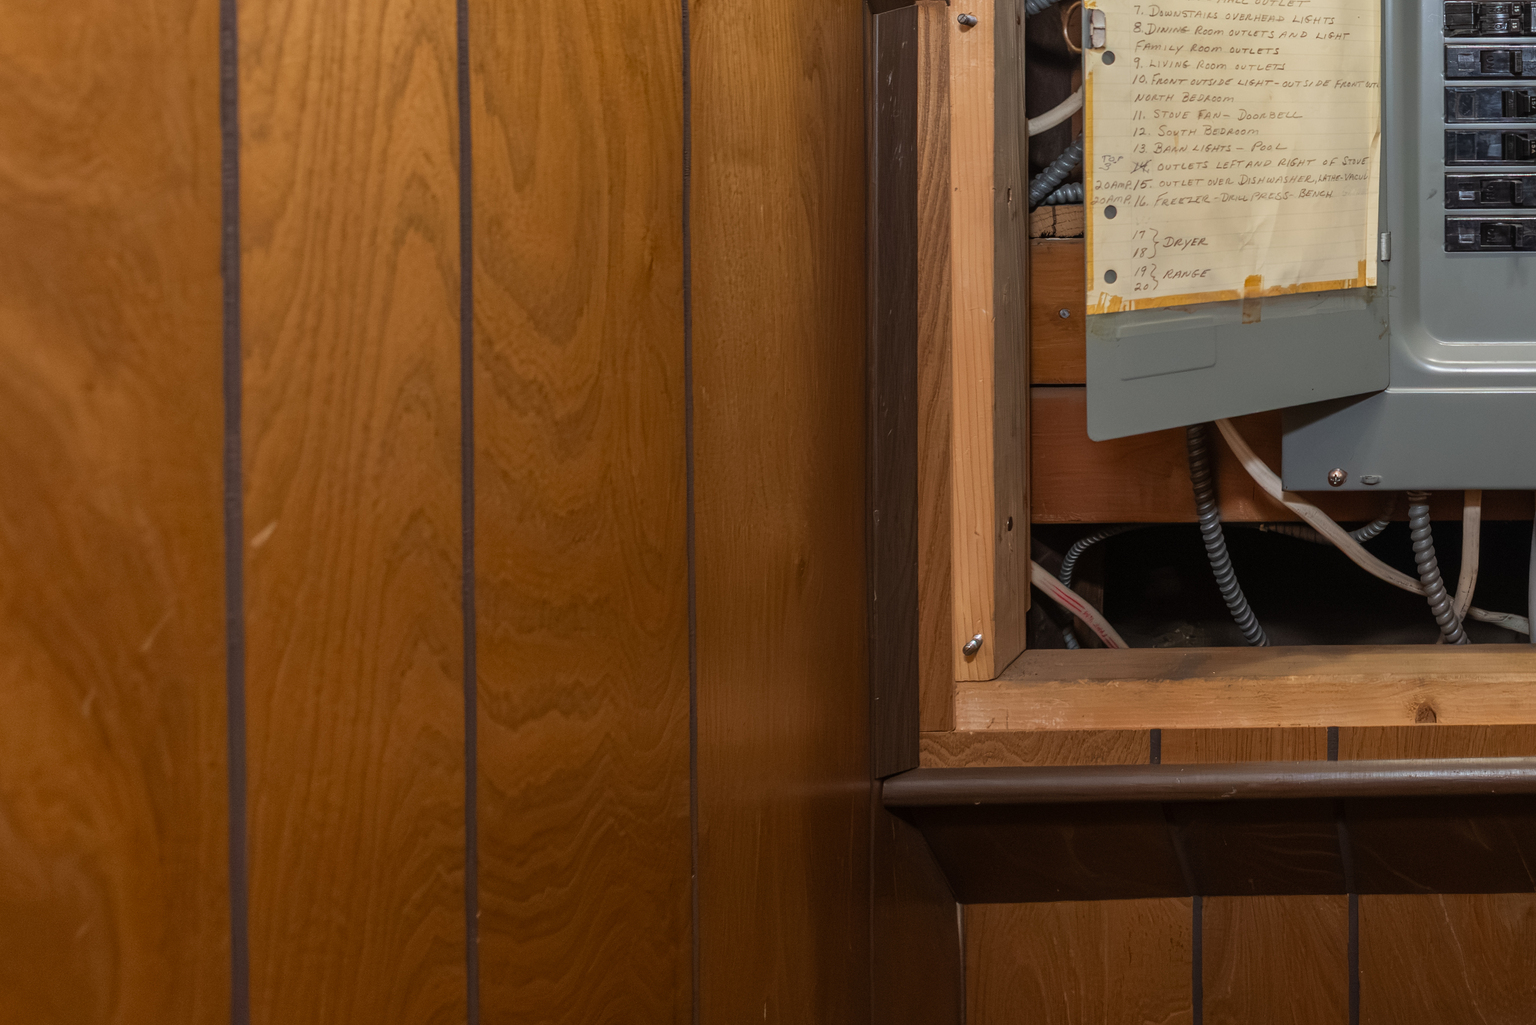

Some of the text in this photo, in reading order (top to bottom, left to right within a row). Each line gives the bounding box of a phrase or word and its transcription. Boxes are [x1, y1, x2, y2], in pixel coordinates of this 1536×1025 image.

[1149, 4, 1218, 20] DOWNSTAIRS
[1225, 13, 1285, 23] OVERHEAD
[1292, 15, 1335, 25] LIGHTS
[1144, 22, 1190, 36] DINING
[1194, 25, 1224, 36] ROOM
[1228, 29, 1275, 39] OUTLETS
[1279, 31, 1308, 39] AND
[1316, 31, 1350, 40] LIGHT
[1135, 39, 1280, 55] FAMILY ROOM OUTLETS
[1149, 60, 1191, 69] LIVING
[1196, 59, 1227, 70] ROOM
[1235, 63, 1286, 71] OUTLETS
[1151, 72, 1188, 85] FRONT
[1190, 78, 1233, 86] OUTSIDE
[1282, 79, 1332, 88] OUTSIDE
[1334, 79, 1365, 89] FRONT
[1134, 91, 1234, 103] NORTH BEDROOM
[1153, 109, 1191, 119] STOVE
[1237, 108, 1303, 121] DOORBELL
[1157, 124, 1198, 137] SOUTH
[1202, 124, 1259, 136] BEDROOM
[1192, 143, 1232, 152] LIGHTS
[1251, 141, 1287, 152] POOL
[1157, 161, 1209, 171] OUTLETS
[1216, 159, 1245, 169] LEFT
[1245, 159, 1272, 169] AND
[1277, 157, 1316, 168] RIGHT
[1322, 157, 1338, 166] OF
[1342, 155, 1369, 166] STOVE
[1159, 178, 1204, 187] OUTLET
[1207, 177, 1234, 186] OVER
[1154, 192, 1211, 207] FREEZER
[1298, 188, 1334, 199] BENCH
[1132, 230, 1146, 240] 17
[1162, 236, 1209, 251] DRYER
[1133, 247, 1148, 258] 18
[1134, 265, 1147, 277] 19
[1162, 268, 1211, 279] RANGE
[1134, 282, 1149, 292] 20
